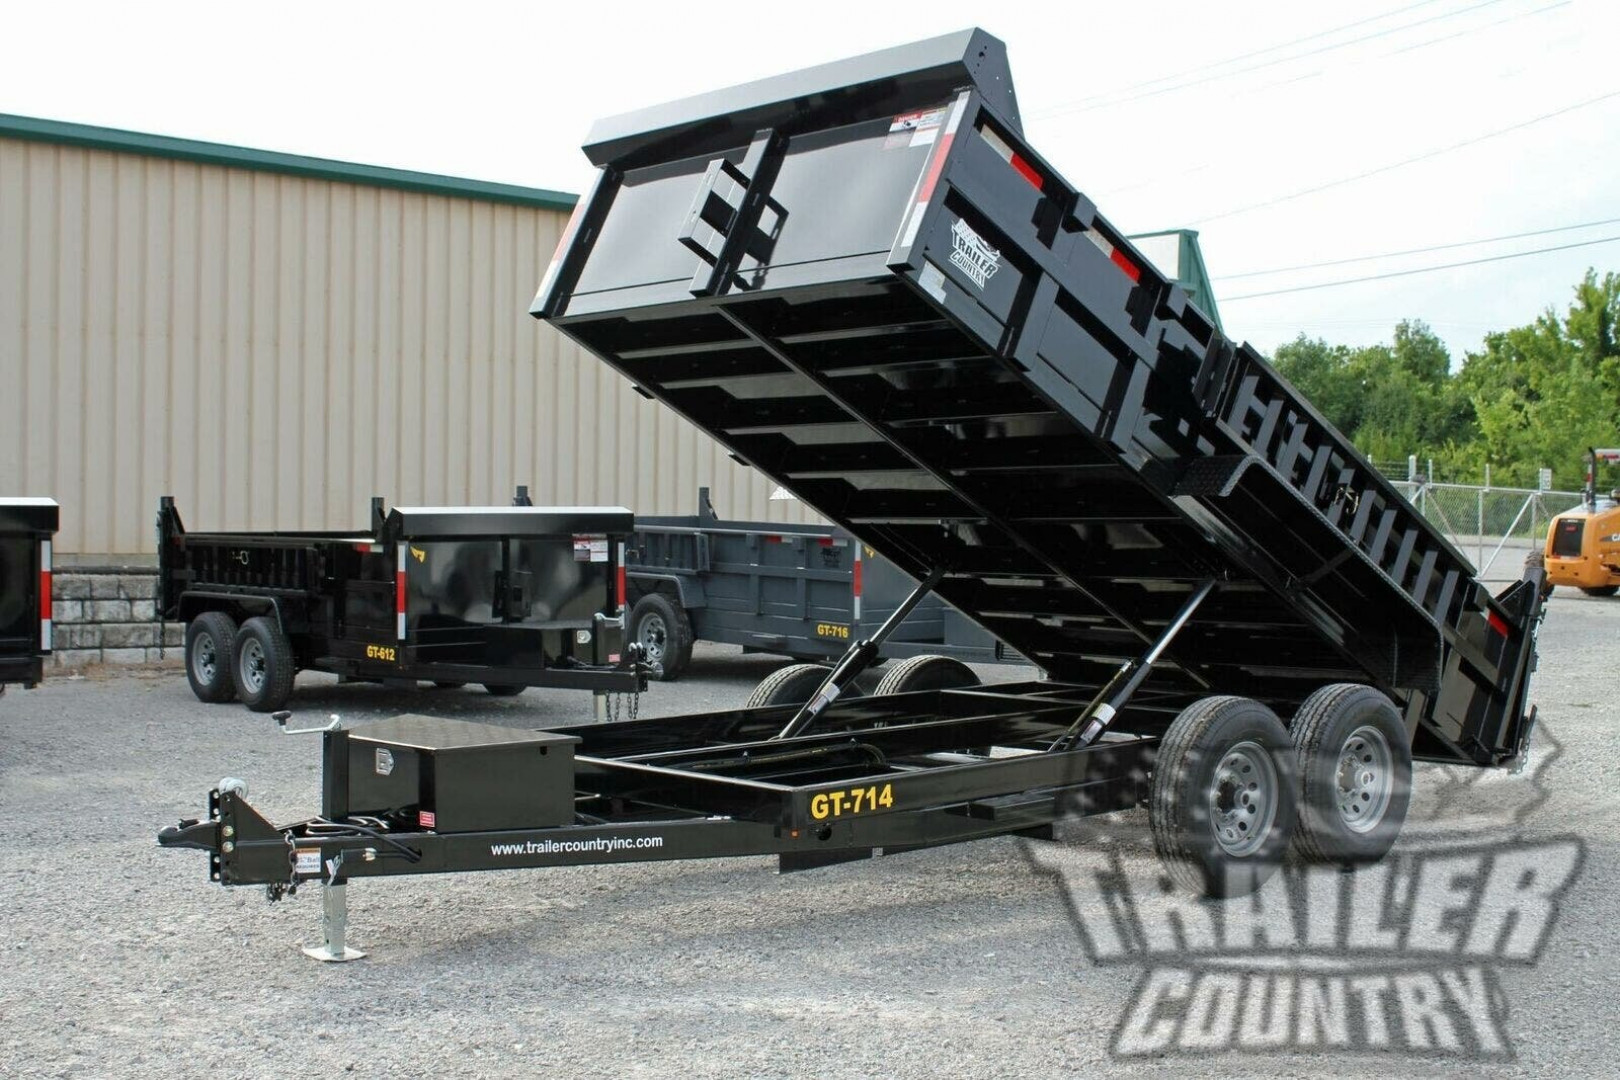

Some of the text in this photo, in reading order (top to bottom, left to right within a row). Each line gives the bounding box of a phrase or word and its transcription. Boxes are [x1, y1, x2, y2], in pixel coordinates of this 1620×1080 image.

[952, 226, 998, 278] TRAILER
[951, 250, 985, 289] COUNTRY
[817, 624, 849, 638] GT-716
[367, 645, 395, 661] GT-612
[811, 784, 893, 819] GT-714
[491, 836, 663, 855] www.trailercountryinc.com
